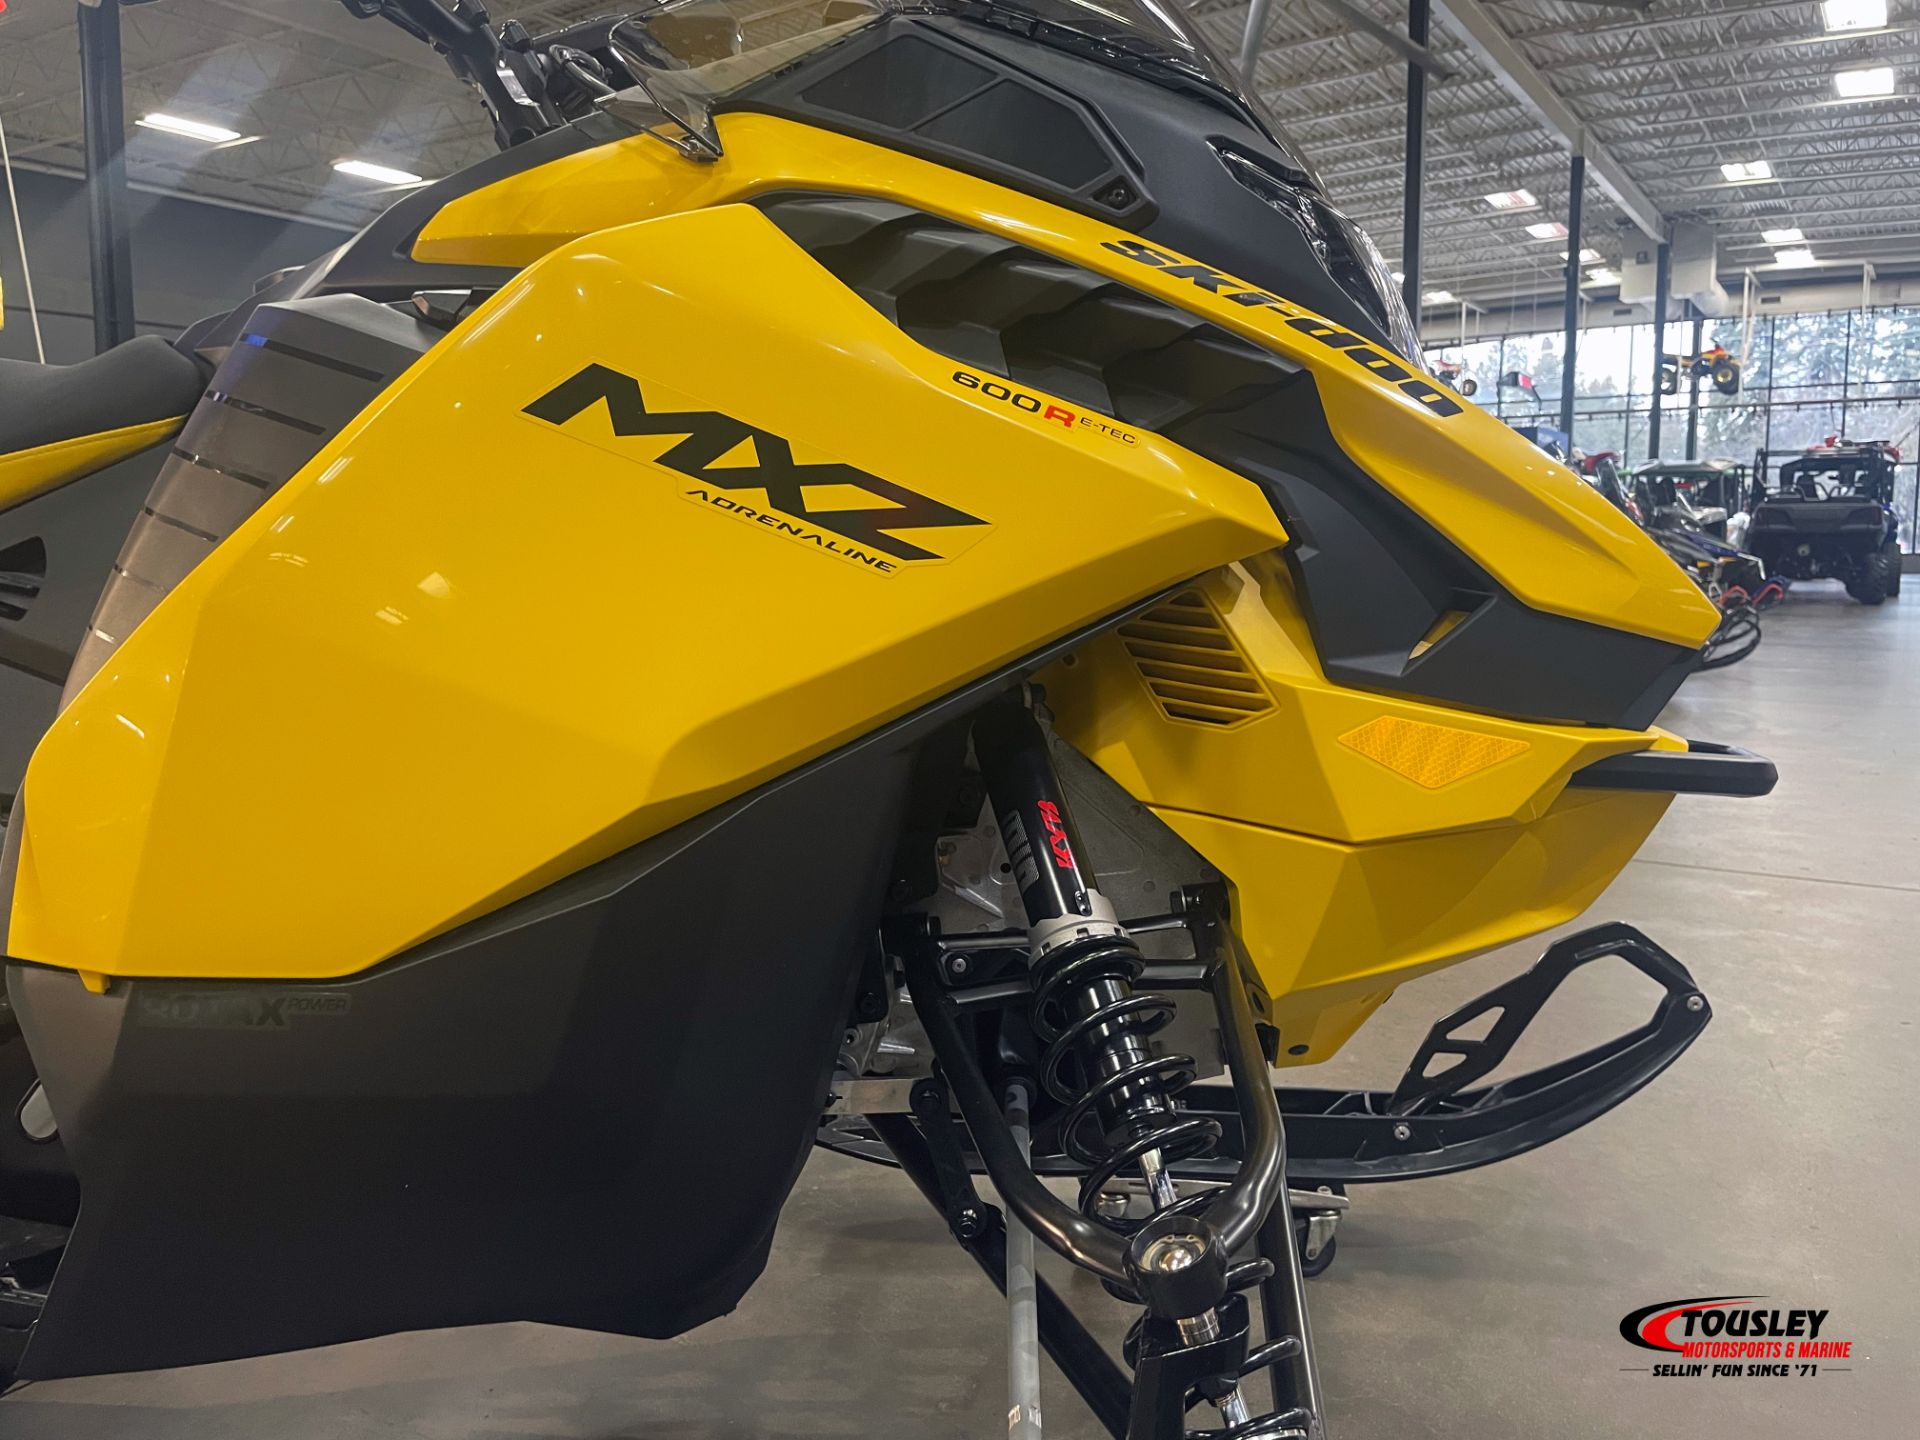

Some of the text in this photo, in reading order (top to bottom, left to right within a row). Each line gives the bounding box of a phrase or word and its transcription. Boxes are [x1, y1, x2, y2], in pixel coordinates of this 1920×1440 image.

[951, 370, 1136, 444] 600R E-TEC
[520, 362, 993, 561] MXZ
[686, 488, 896, 573] ADRENALINE
[288, 997, 347, 1012] POWER
